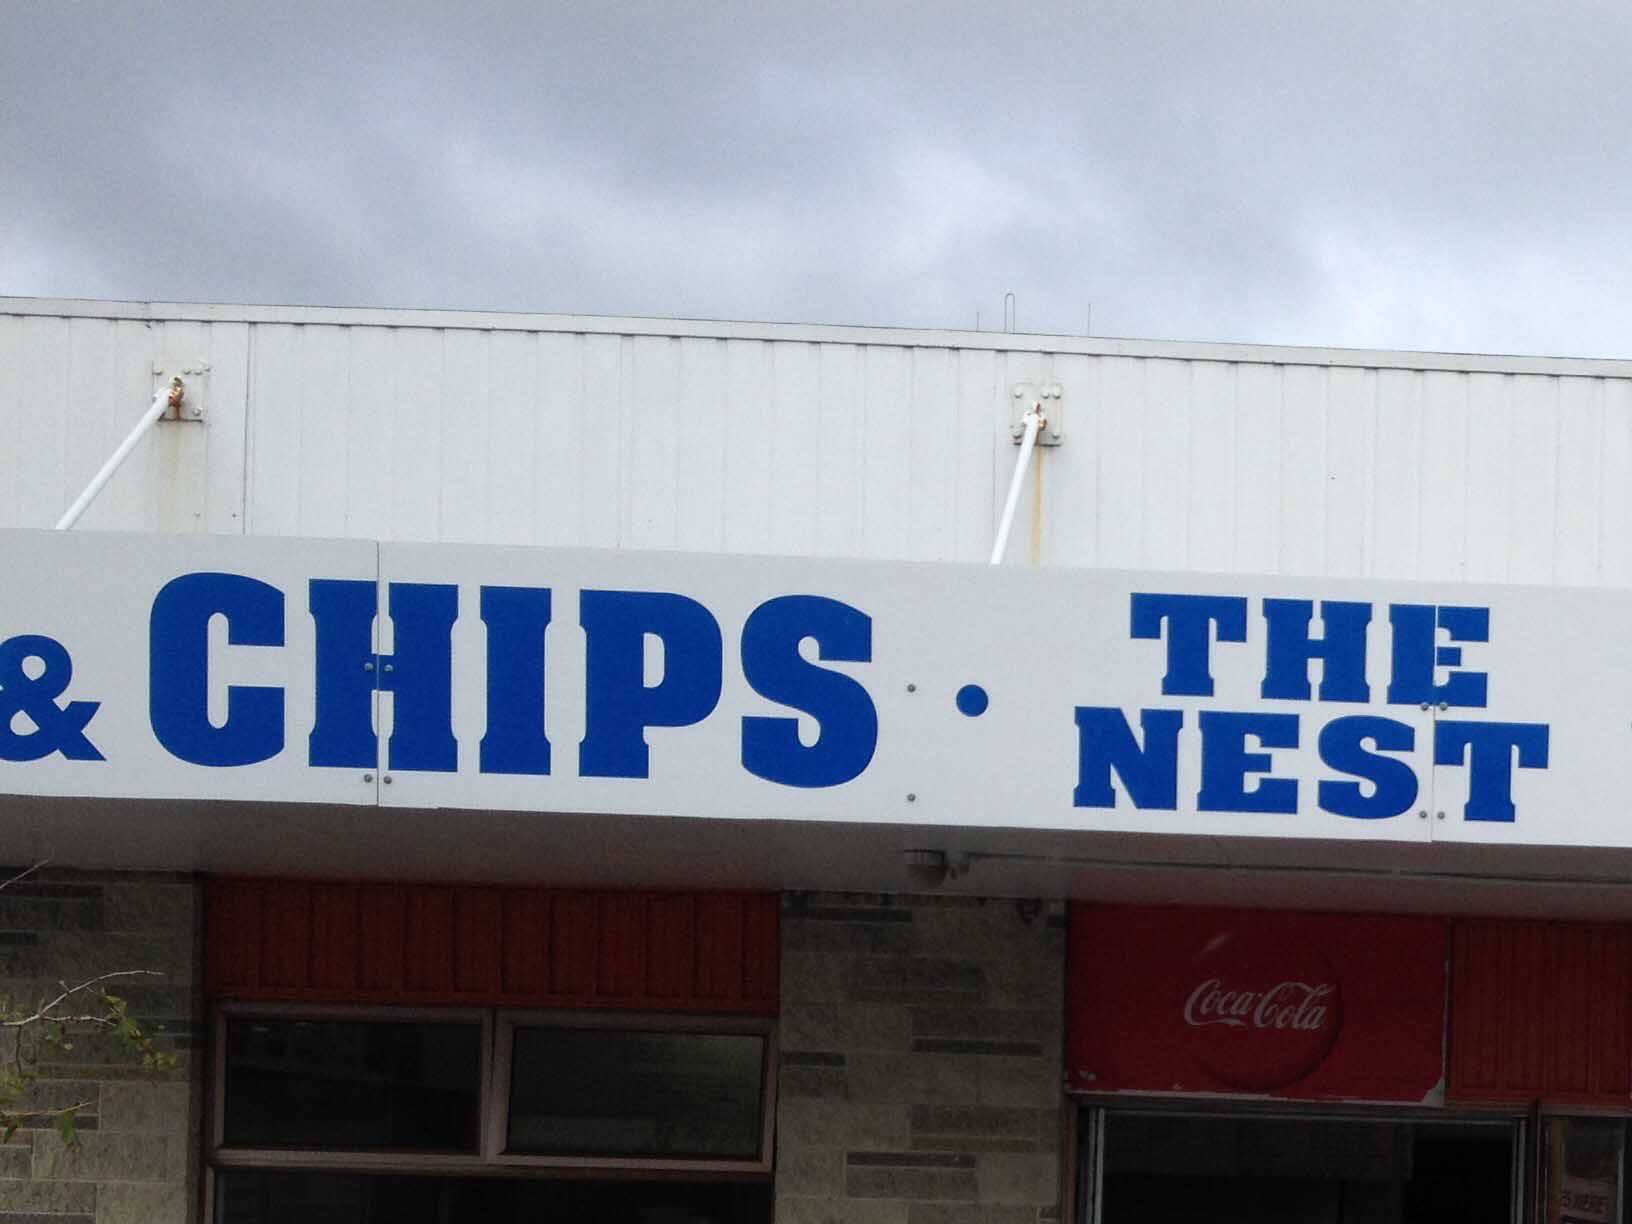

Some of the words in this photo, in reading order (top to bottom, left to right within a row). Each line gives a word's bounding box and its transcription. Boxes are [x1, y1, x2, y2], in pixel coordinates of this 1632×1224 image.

[0, 634, 106, 762] &
[149, 572, 879, 789] CHIPS
[1130, 592, 1490, 708] THE
[1073, 706, 1550, 822] NEST
[1184, 978, 1332, 1031] Coca-Cola
